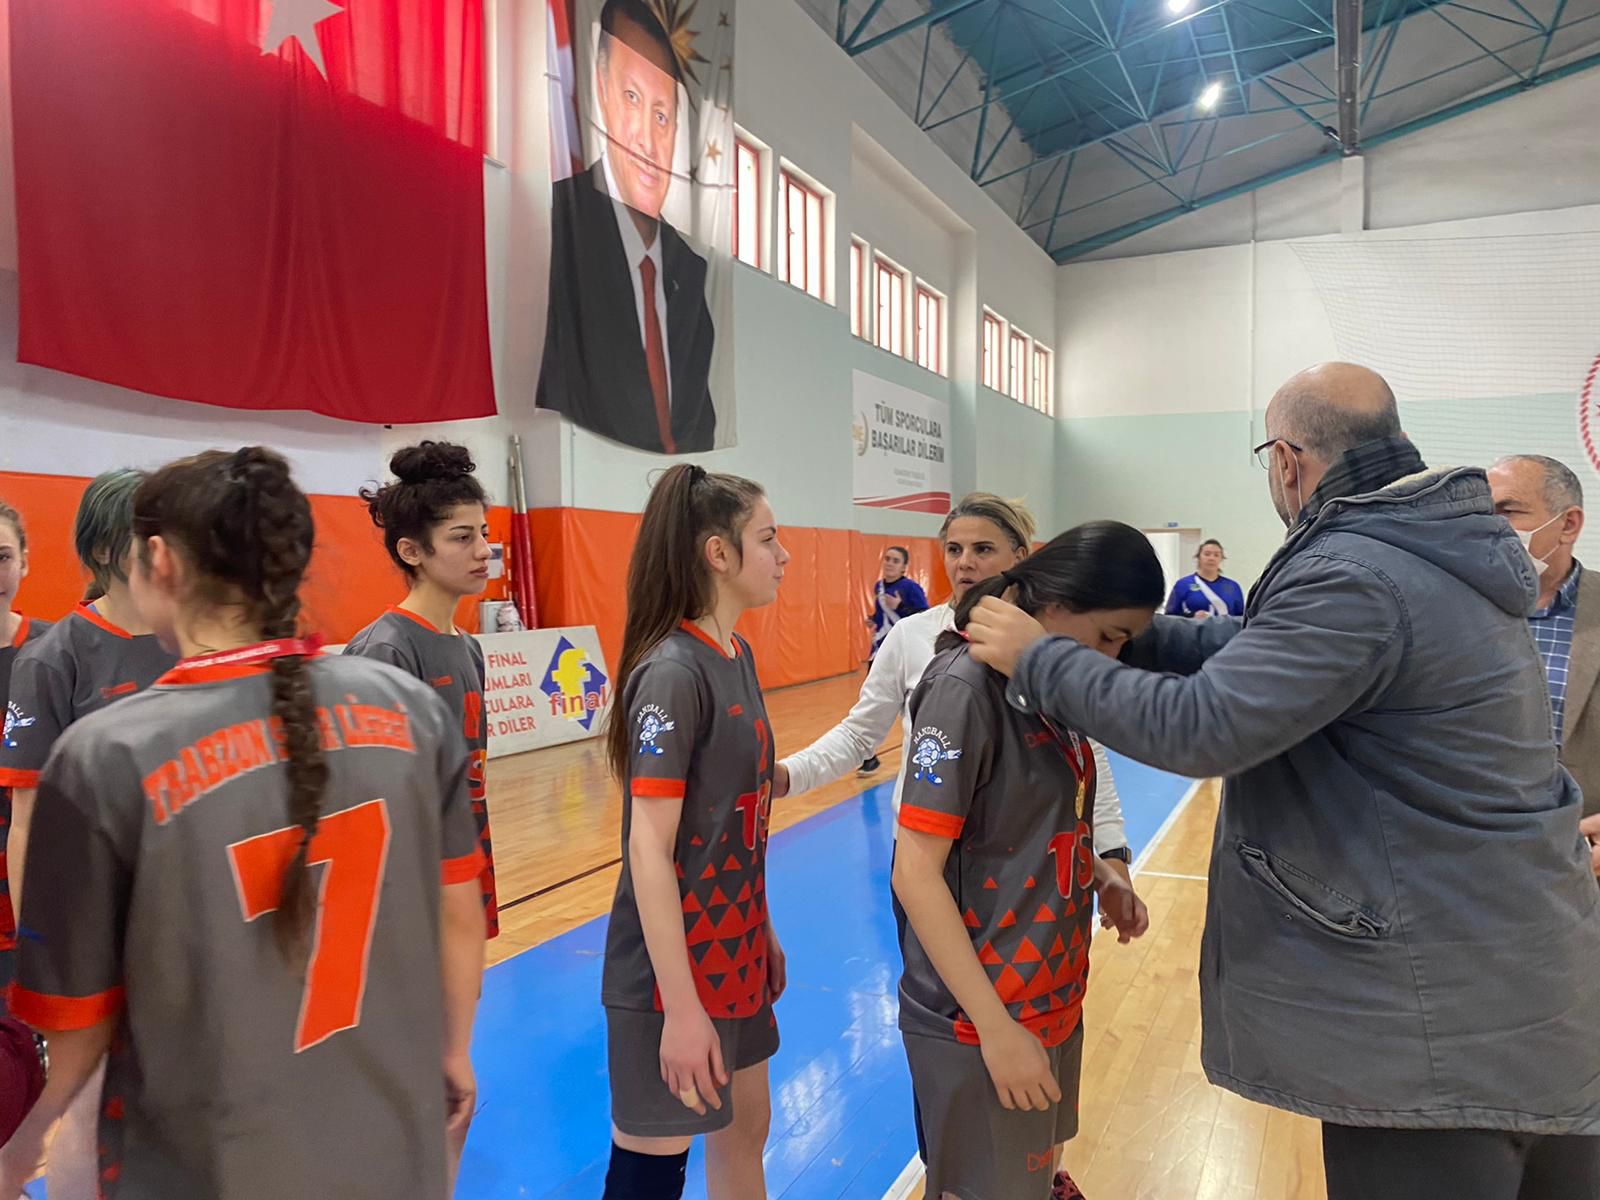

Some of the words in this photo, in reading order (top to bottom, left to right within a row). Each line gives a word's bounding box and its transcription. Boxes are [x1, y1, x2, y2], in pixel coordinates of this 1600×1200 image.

[875, 400, 893, 426] TÜM
[895, 410, 942, 439] SPORCULARA
[488, 650, 527, 669] FİNAL
[549, 686, 607, 716] final
[498, 715, 537, 736] DİLER
[913, 726, 951, 749] HANDBALL
[225, 797, 393, 1054] 7
